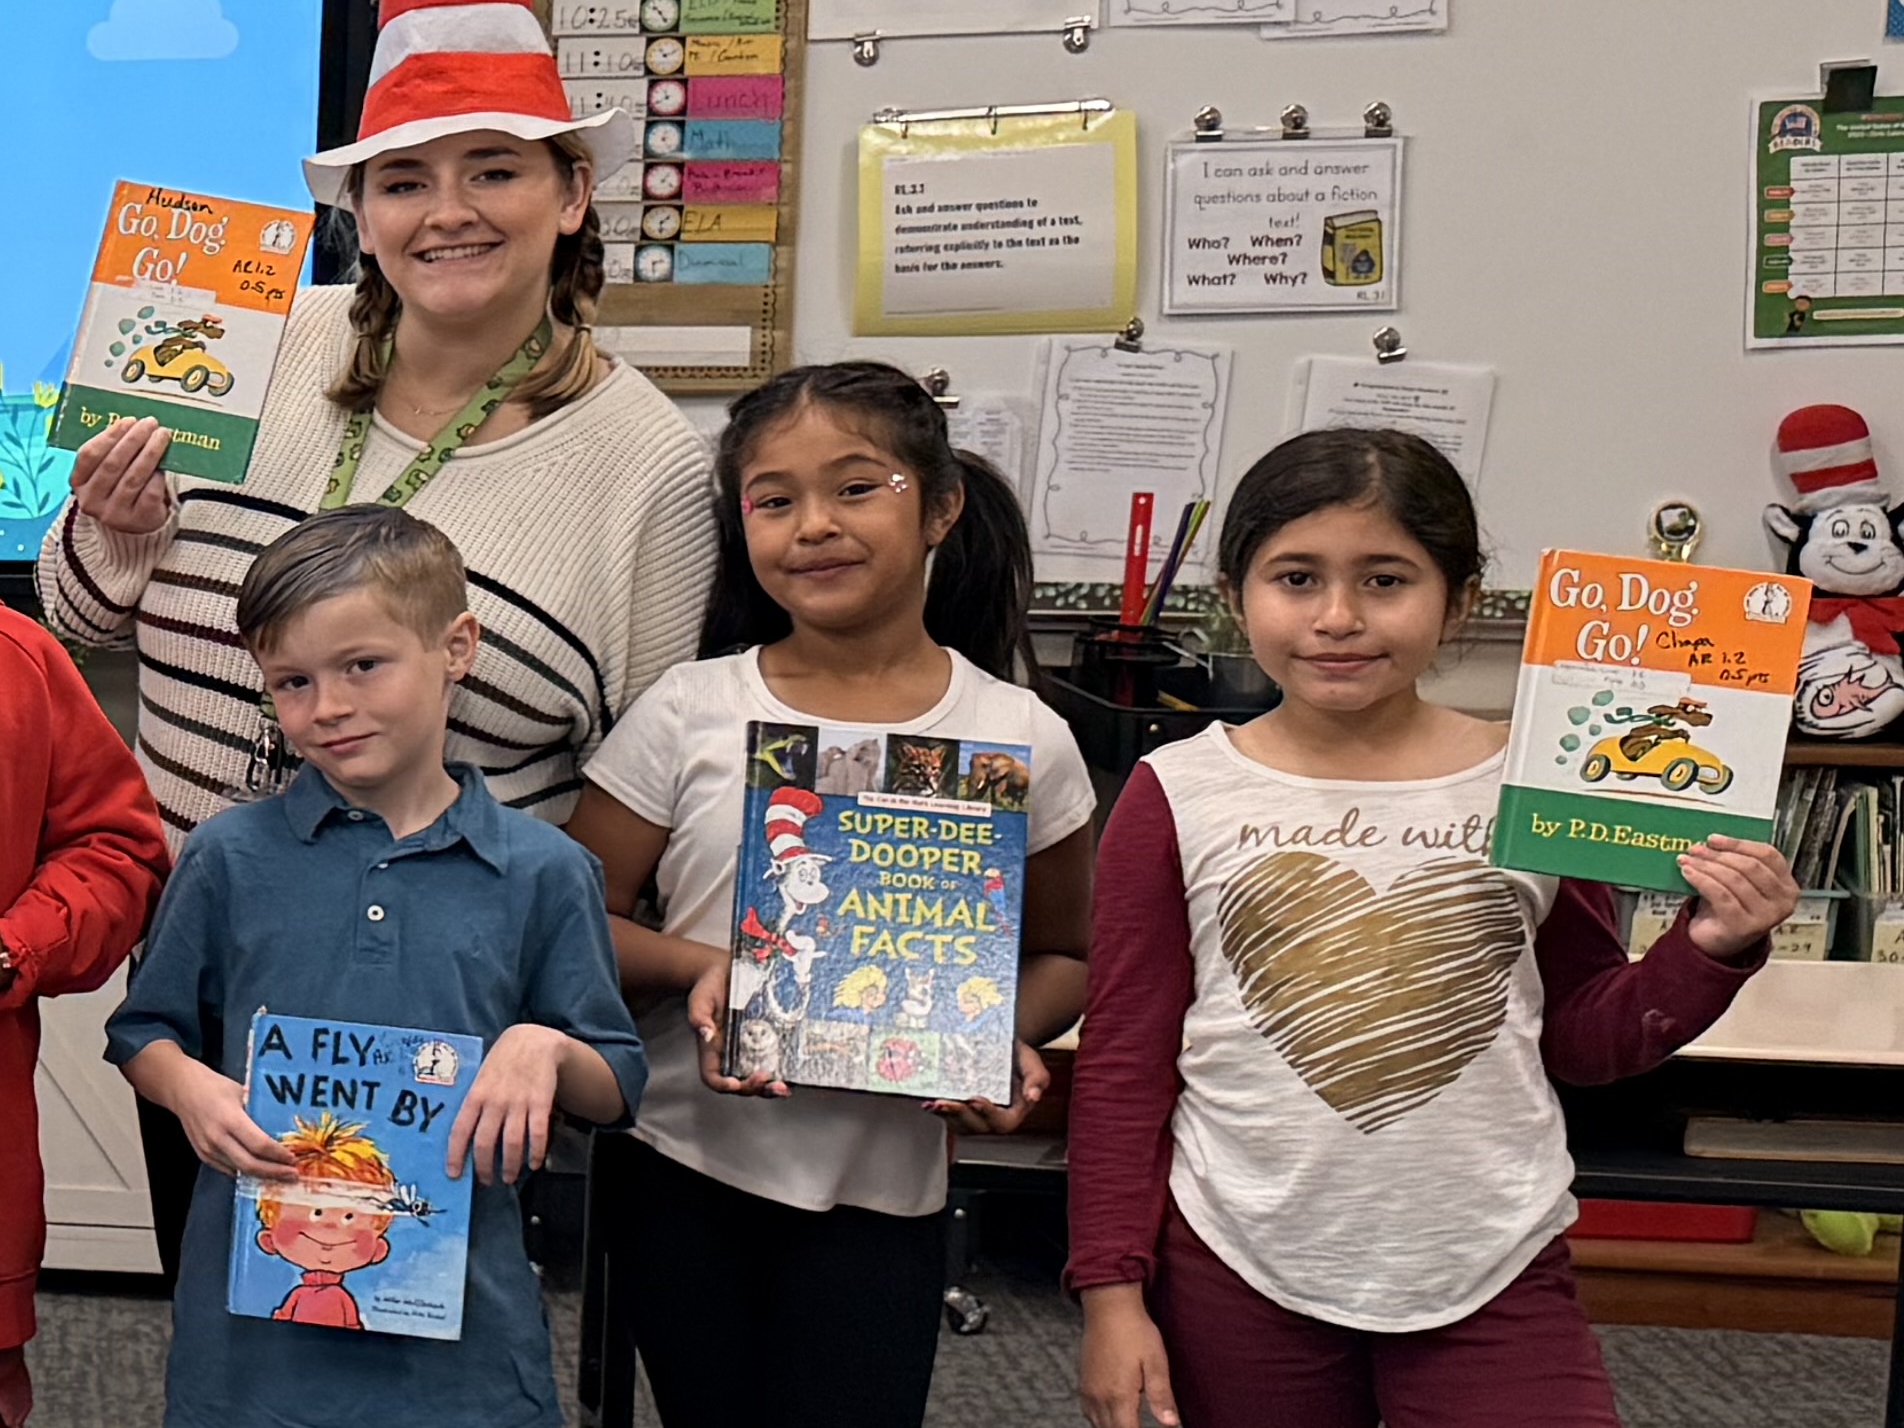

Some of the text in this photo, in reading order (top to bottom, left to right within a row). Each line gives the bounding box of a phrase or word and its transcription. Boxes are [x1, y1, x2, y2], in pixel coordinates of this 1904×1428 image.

[1203, 161, 1370, 178] I can ask and answer
[146, 187, 214, 214] Hudson
[1194, 186, 1377, 210] questions about a fiction
[118, 202, 230, 256] Go, Dog.
[684, 211, 722, 233] ELA
[1269, 213, 1300, 229] text!
[1188, 235, 1302, 249] Who? When?
[132, 247, 188, 285] Go!
[1228, 253, 1287, 266] Where?
[1187, 274, 1307, 287] What? Why?
[80, 406, 102, 427] by
[1548, 566, 1701, 629] Go, Dog.
[1576, 620, 1650, 666] Go!
[1719, 650, 1747, 666] 1.2
[838, 809, 1002, 845] SUPER-DEE-
[1237, 808, 1389, 850] made
[1531, 813, 1561, 837] by
[848, 838, 981, 875] DOOPER
[879, 871, 959, 890] BOOK OF
[836, 888, 997, 933] ANIMAL
[849, 924, 978, 966] FACTS
[258, 1024, 375, 1066] A FLY
[263, 1074, 444, 1133] WENT BY
